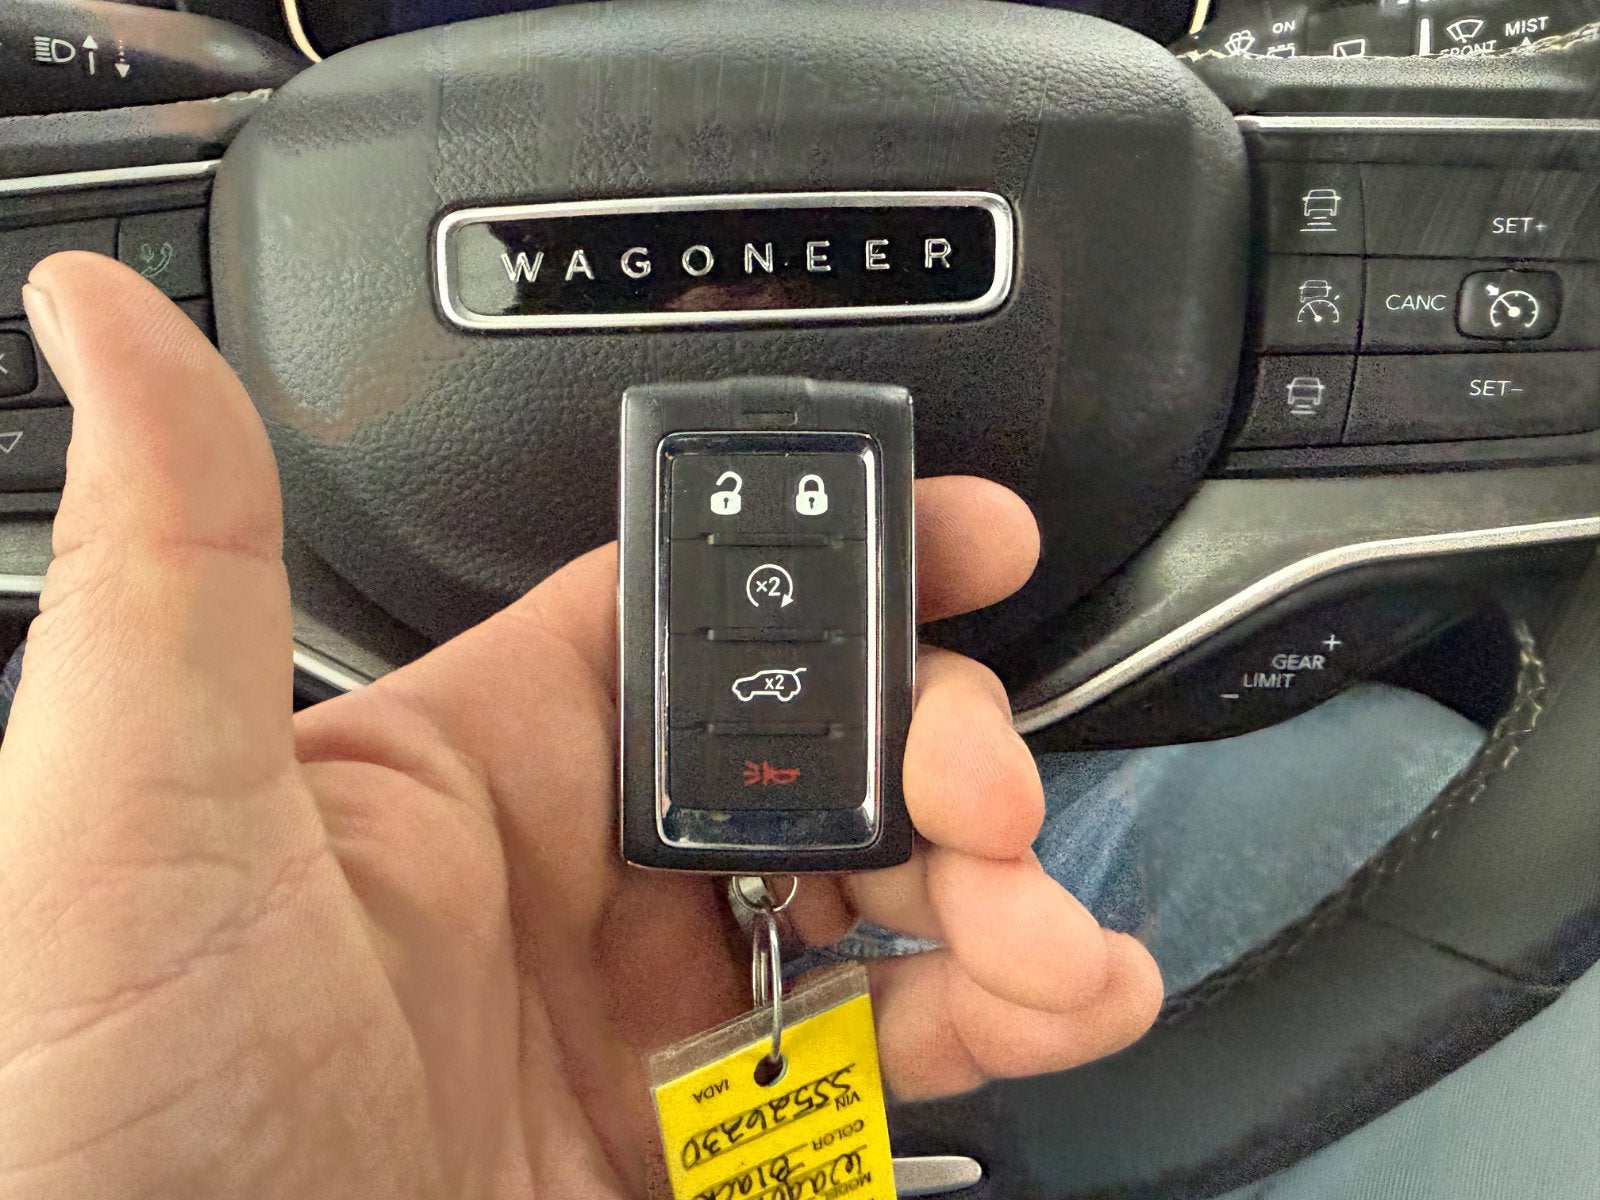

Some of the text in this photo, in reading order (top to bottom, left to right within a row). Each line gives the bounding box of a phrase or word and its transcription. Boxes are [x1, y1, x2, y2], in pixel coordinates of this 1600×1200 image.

[1272, 20, 1296, 34] ON
[1505, 16, 1549, 37] MIST
[501, 237, 954, 283] WAGONEER
[1385, 294, 1446, 311] CANC
[1272, 654, 1326, 670] GEAR
[1243, 673, 1295, 688] LIMIT
[692, 1079, 730, 1104] IADA
[835, 1091, 861, 1111] VIN
[812, 1119, 864, 1151] COLOR
